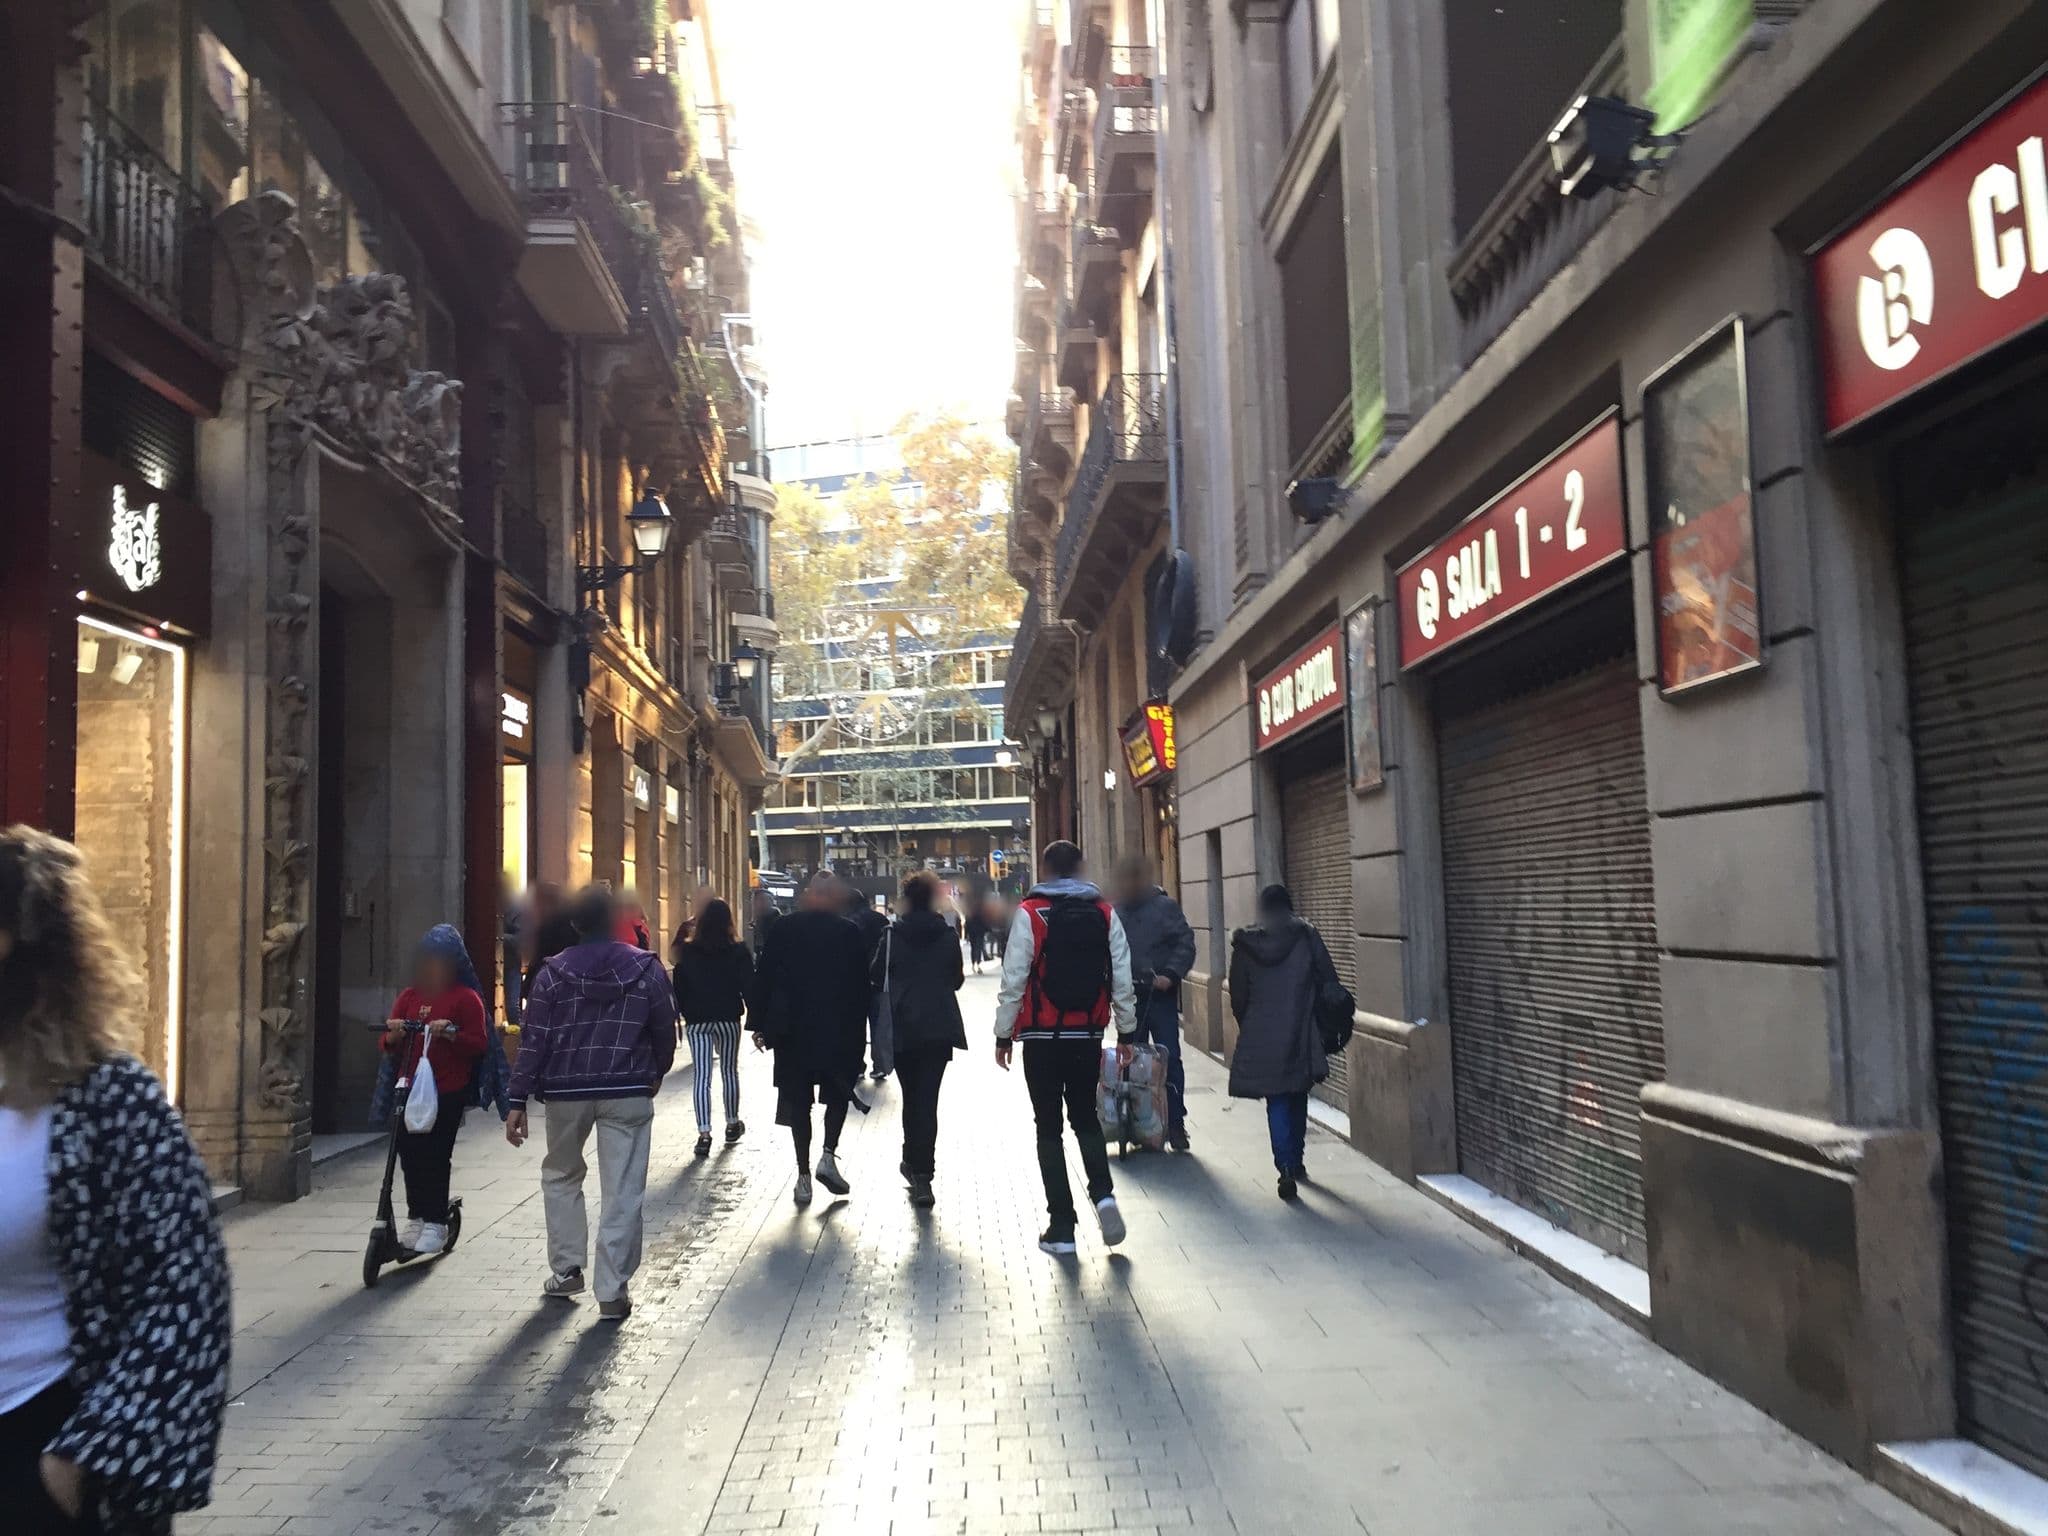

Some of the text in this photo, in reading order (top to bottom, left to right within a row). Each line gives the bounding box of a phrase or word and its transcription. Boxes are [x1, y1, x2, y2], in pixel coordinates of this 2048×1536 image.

[1446, 528, 1503, 620] SALA
[1514, 506, 1531, 579] 1
[1564, 469, 1588, 552] 2
